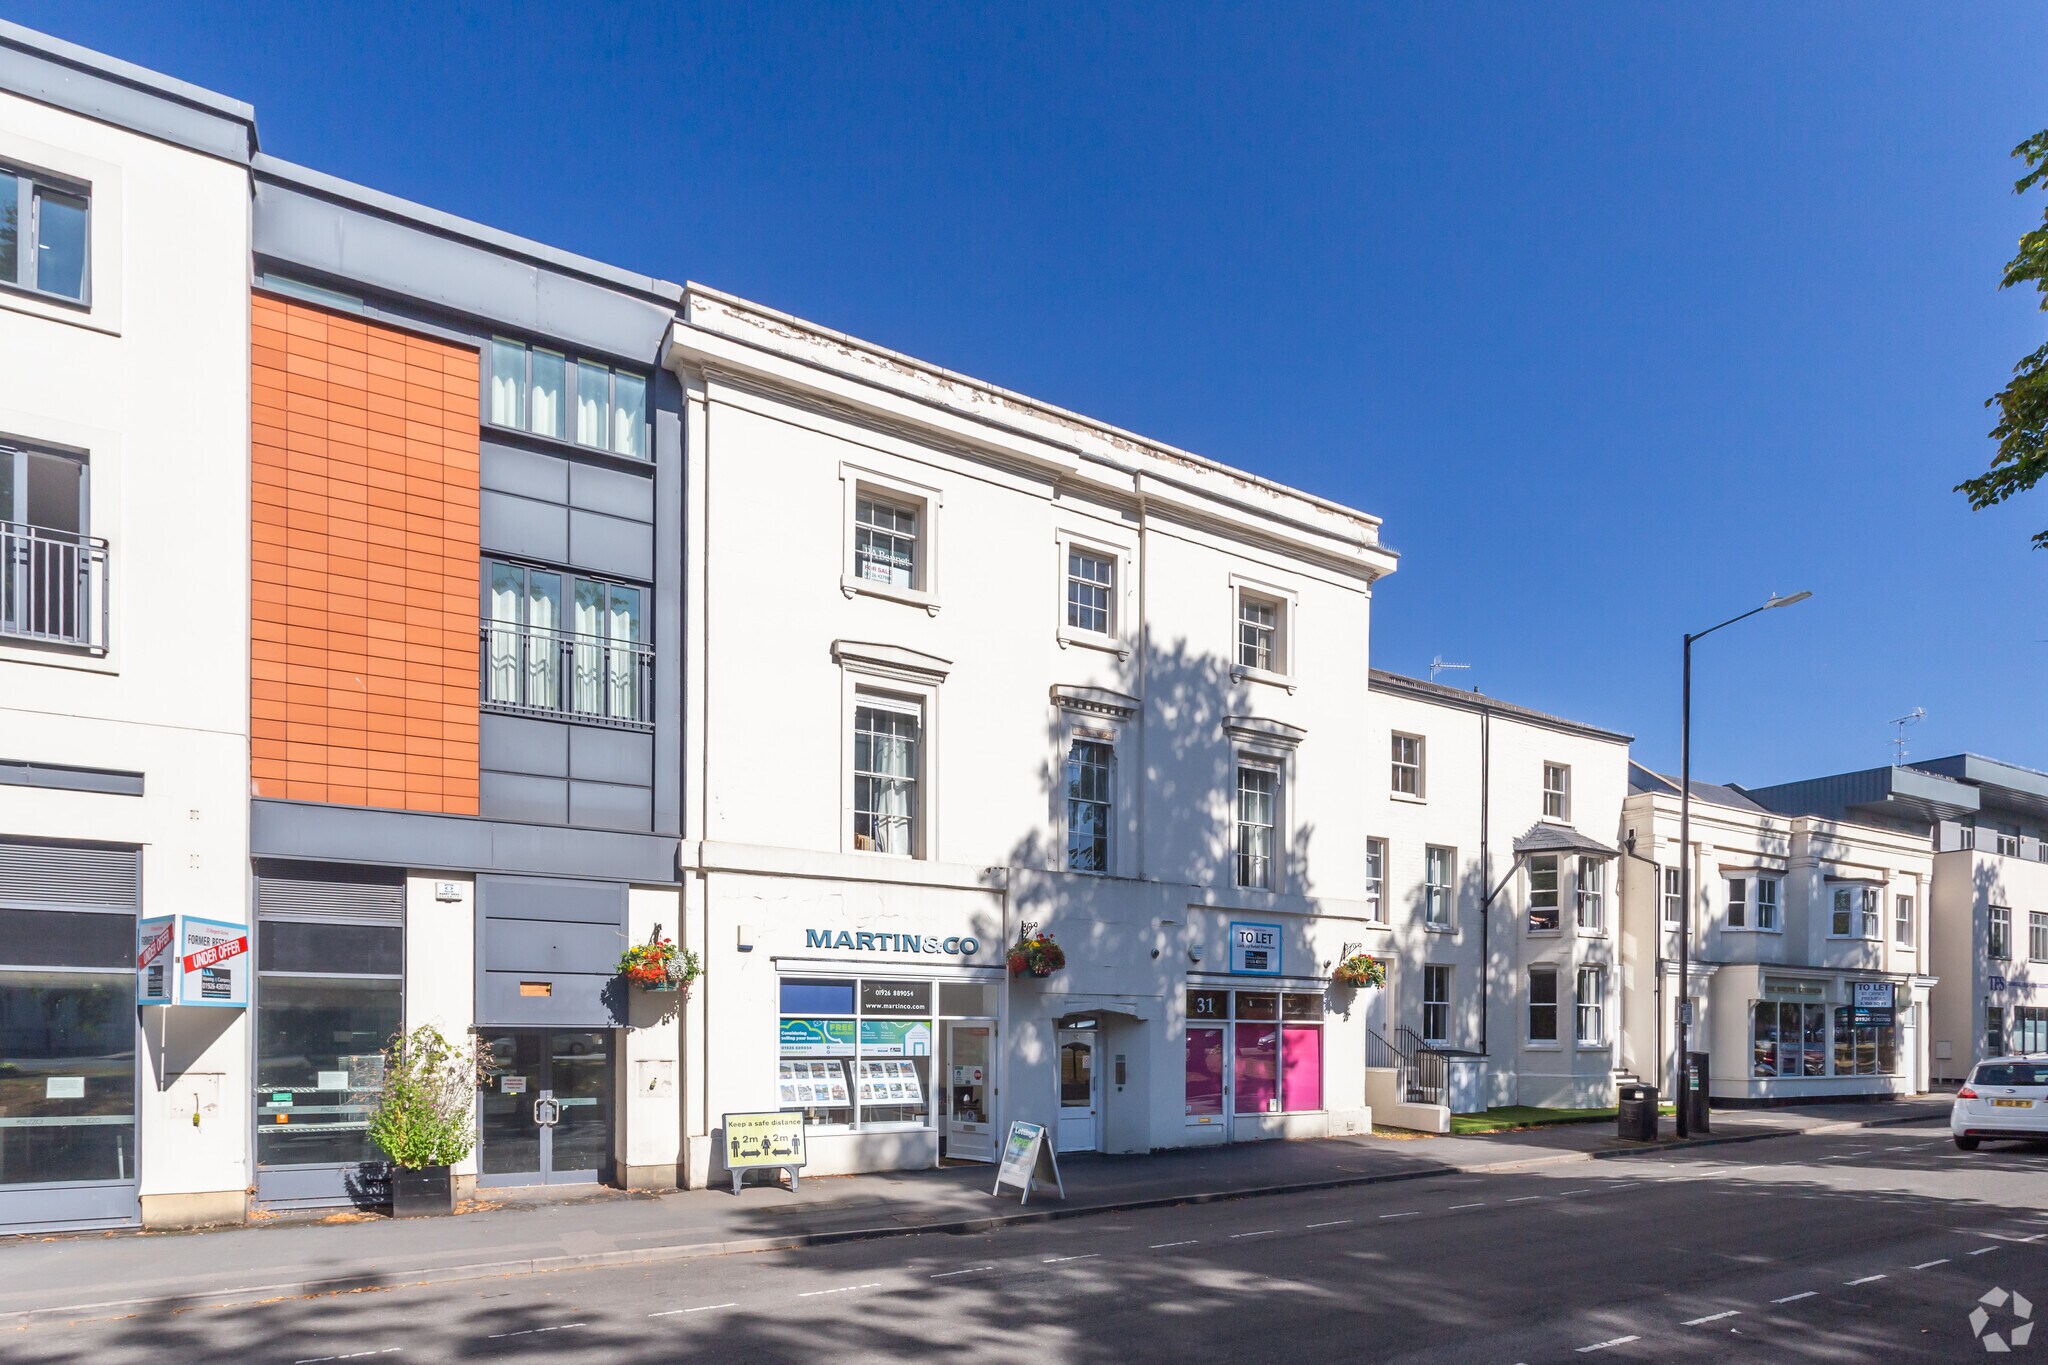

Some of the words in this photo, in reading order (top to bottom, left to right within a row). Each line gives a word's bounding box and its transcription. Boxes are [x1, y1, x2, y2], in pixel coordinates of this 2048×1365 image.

[188, 934, 210, 947] FORMER
[1240, 931, 1253, 943] TO
[1256, 933, 1273, 944] LET
[143, 942, 157, 964] UNDER
[156, 929, 170, 951] OFFER
[192, 948, 217, 968] UNDER
[218, 940, 241, 959] OFFER
[875, 989, 891, 997] 01926
[893, 989, 914, 997] 889054
[1196, 997, 1214, 1013] 31
[829, 1023, 854, 1031] FREE
[742, 1135, 759, 1143] 2m
[773, 1134, 789, 1142] 2m
[1015, 1126, 1038, 1139] Lettings
